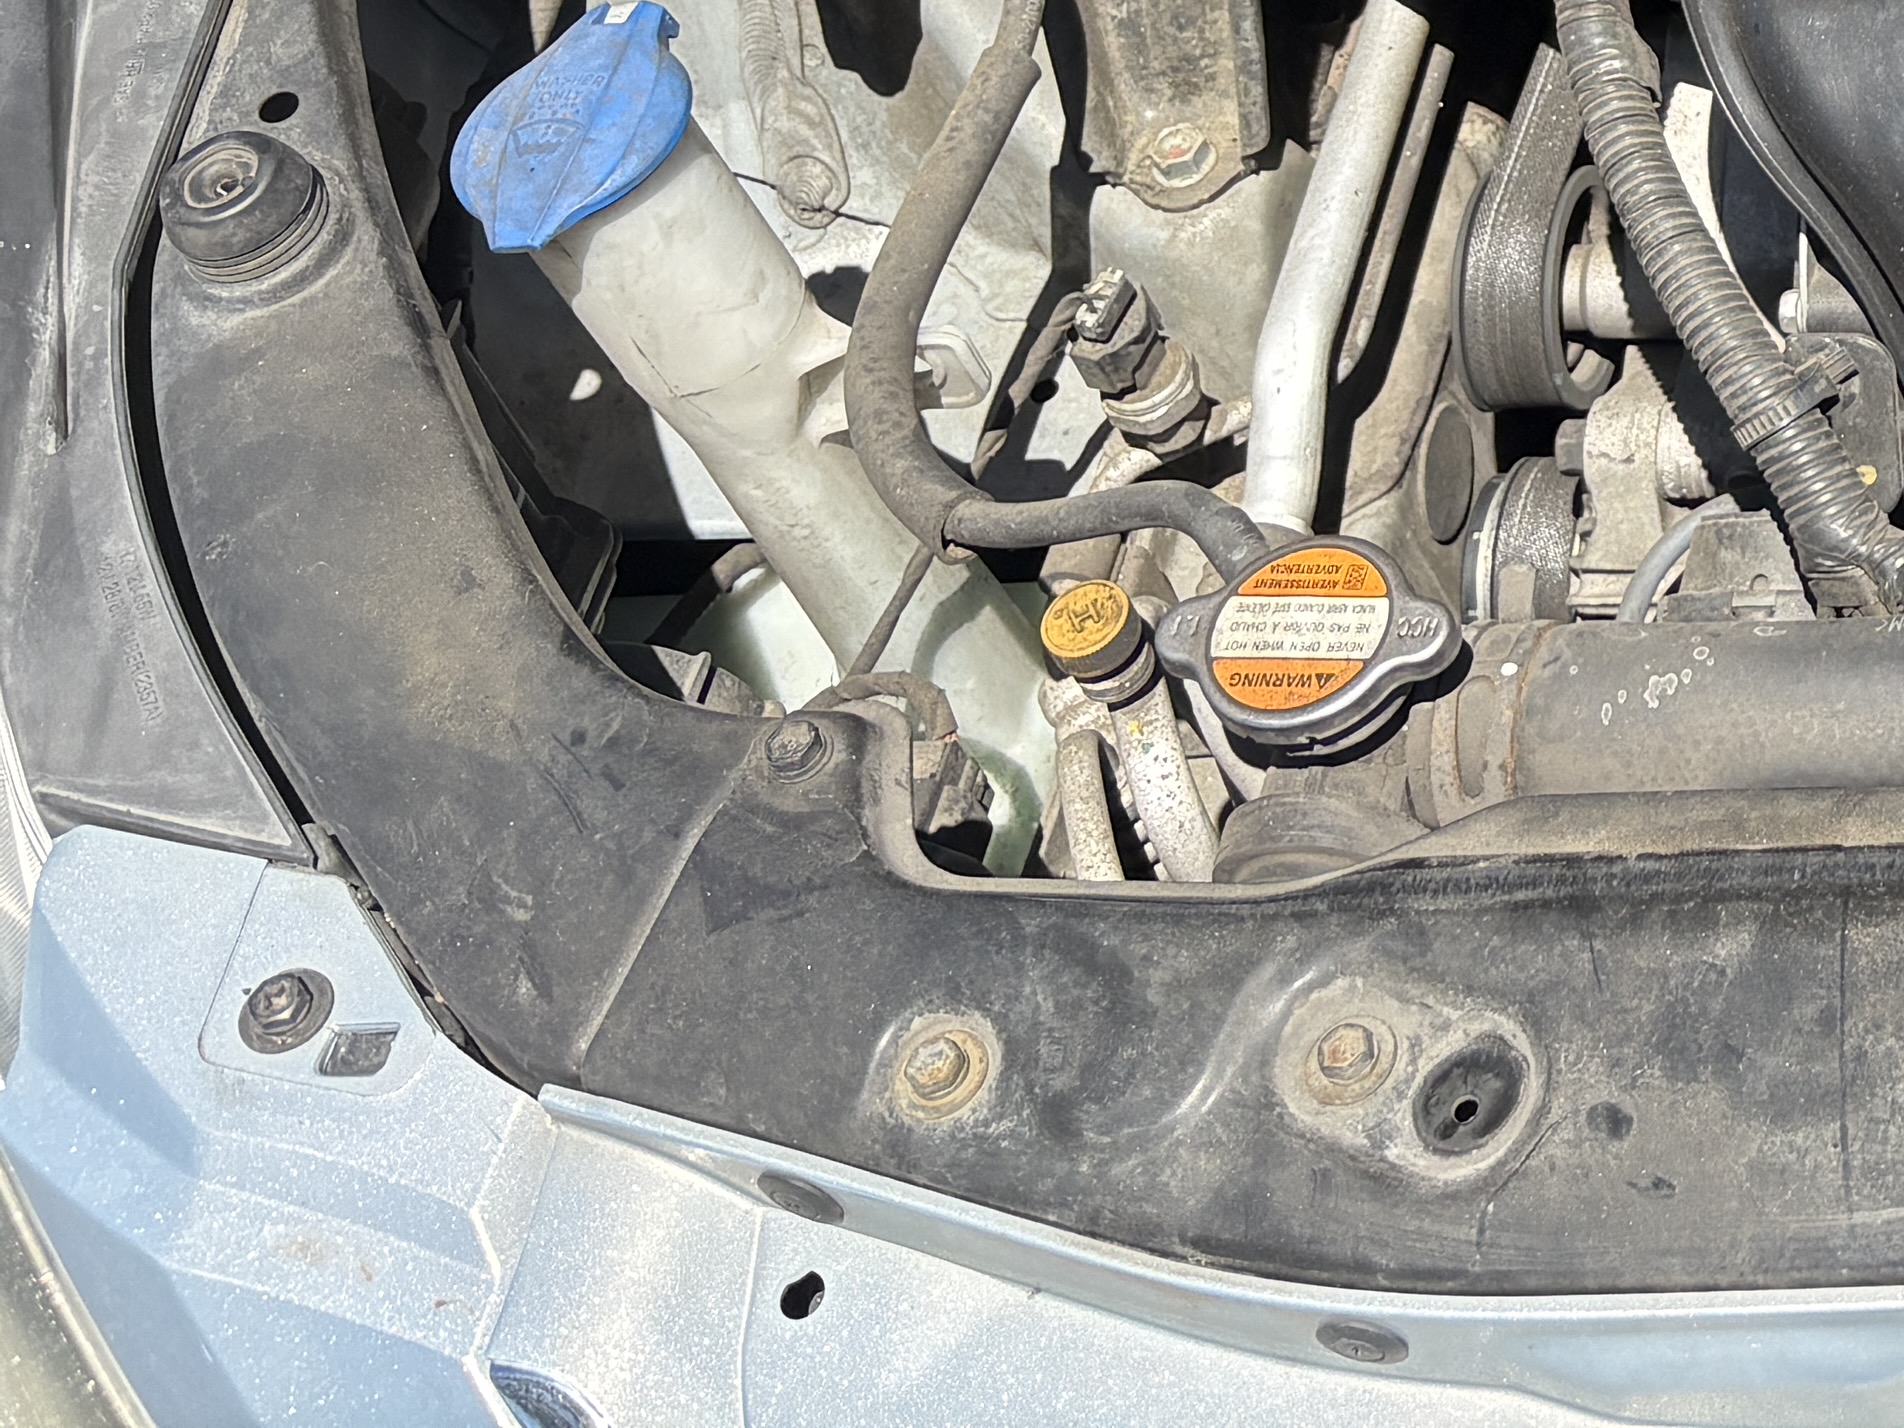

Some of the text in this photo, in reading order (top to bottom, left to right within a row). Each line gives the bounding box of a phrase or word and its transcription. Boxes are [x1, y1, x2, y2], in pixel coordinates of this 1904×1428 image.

[1269, 563, 1343, 575] ADVERTENCIA
[1252, 578, 1342, 591] AVERTISSEMENT
[1229, 620, 1268, 632] CHAUD
[1328, 622, 1351, 633] PAS
[1397, 615, 1440, 639] HCC
[1223, 639, 1365, 653] NEVER OPEN WHEN HOT
[1228, 672, 1313, 689] WARNING
